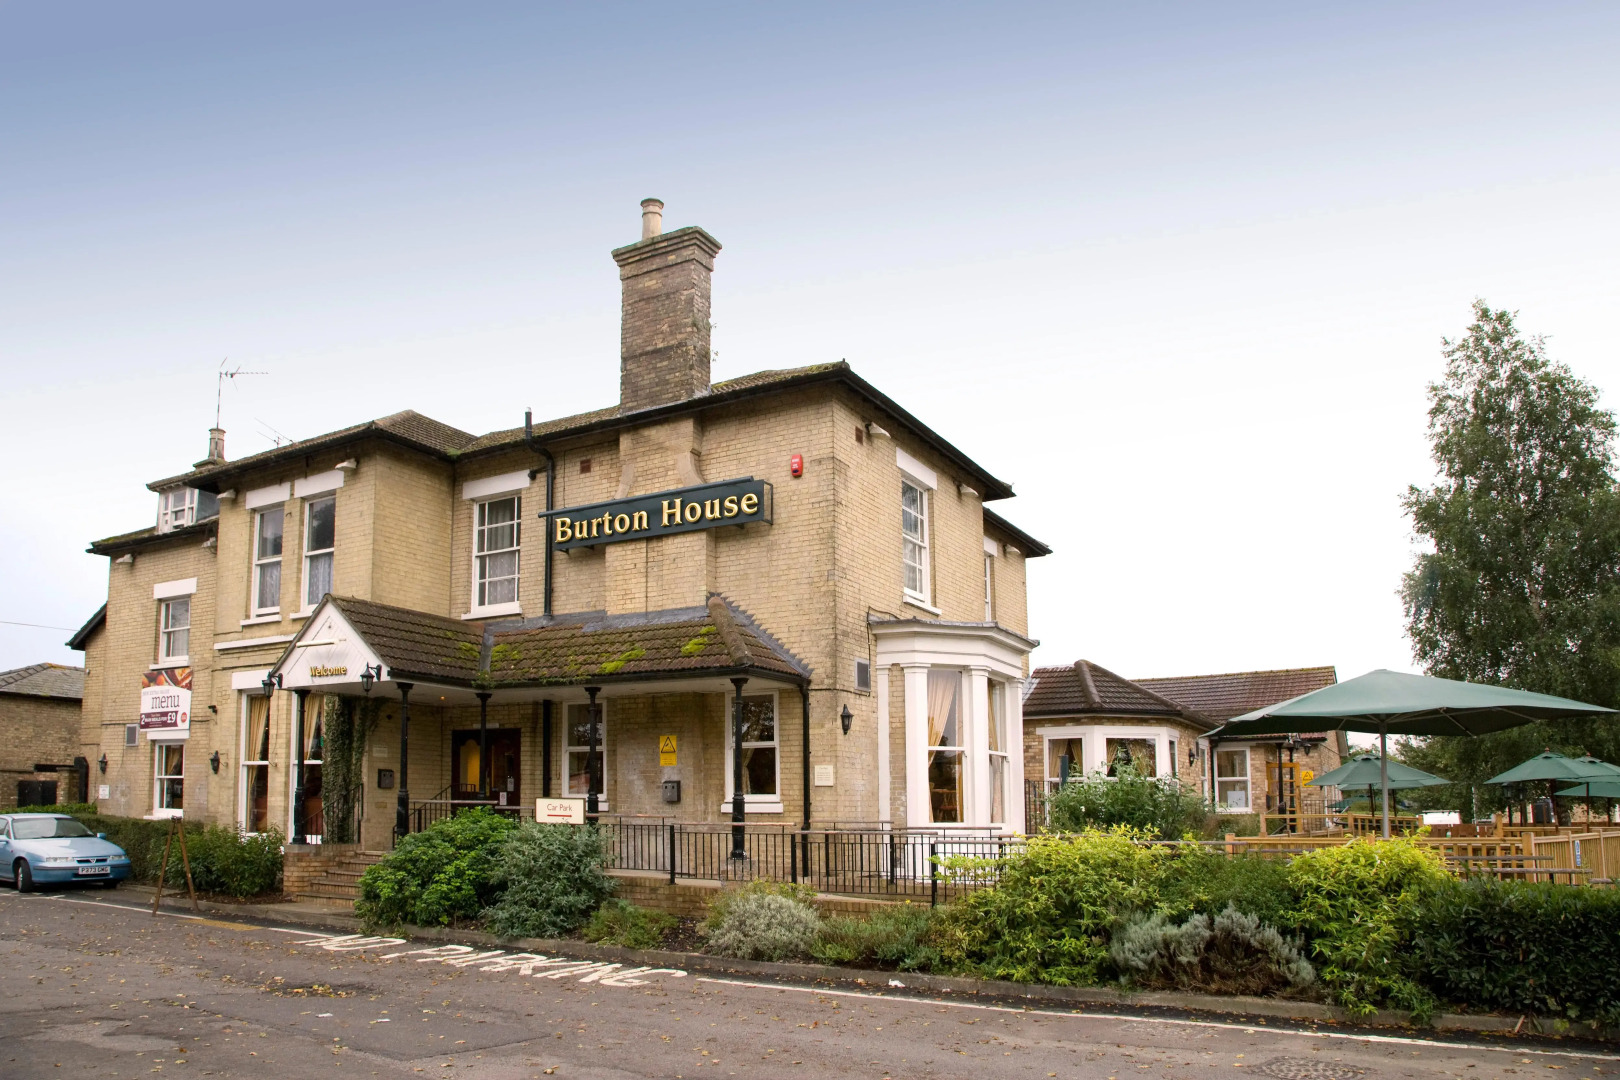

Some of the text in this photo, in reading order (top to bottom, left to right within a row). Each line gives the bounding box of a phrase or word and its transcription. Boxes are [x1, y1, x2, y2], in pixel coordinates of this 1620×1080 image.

[554, 492, 759, 543] Burton House
[310, 664, 347, 676] Welcome
[151, 695, 180, 709] menu
[141, 714, 146, 725] 2
[167, 712, 176, 723] £9
[547, 803, 558, 811] Car
[293, 934, 688, 987] NO PARKING
